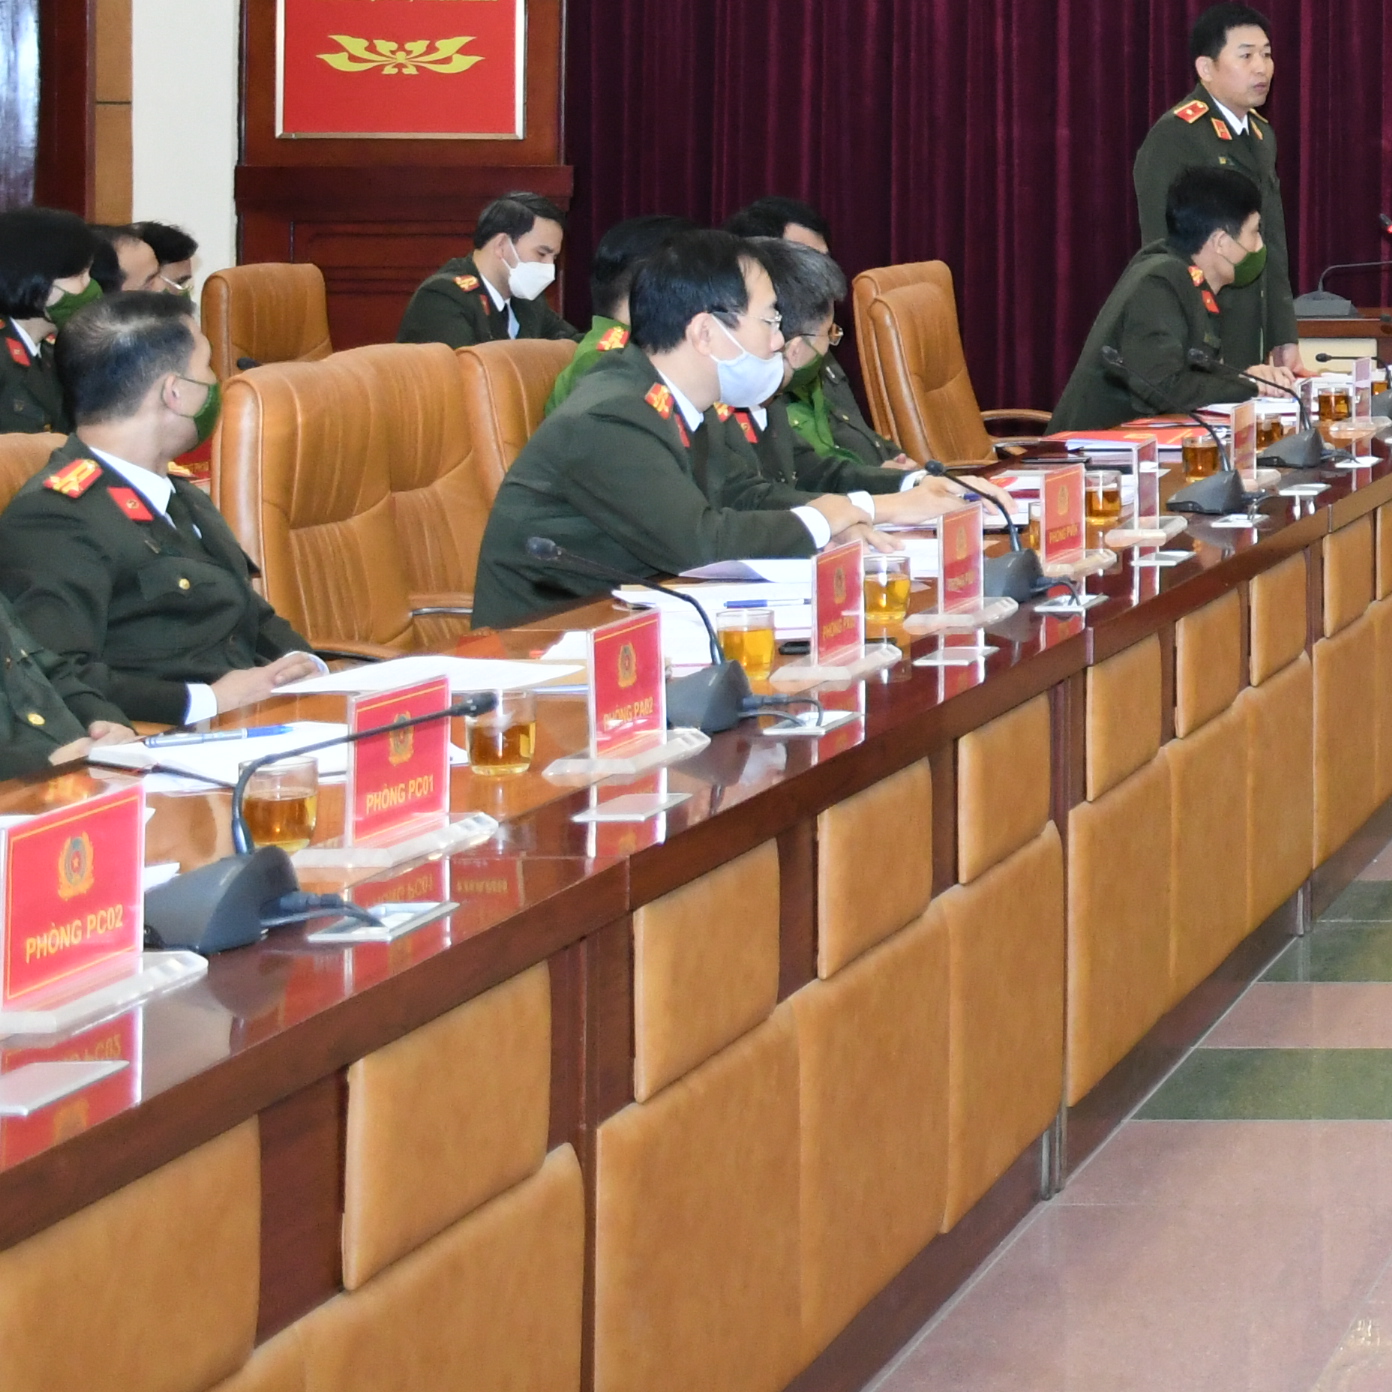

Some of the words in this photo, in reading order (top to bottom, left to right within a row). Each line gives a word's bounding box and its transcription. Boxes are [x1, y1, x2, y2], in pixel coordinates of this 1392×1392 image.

[366, 783, 406, 815] PHÒNG
[408, 774, 434, 800] PC01
[26, 920, 82, 963] PHÒNG
[86, 904, 124, 938] PC02
